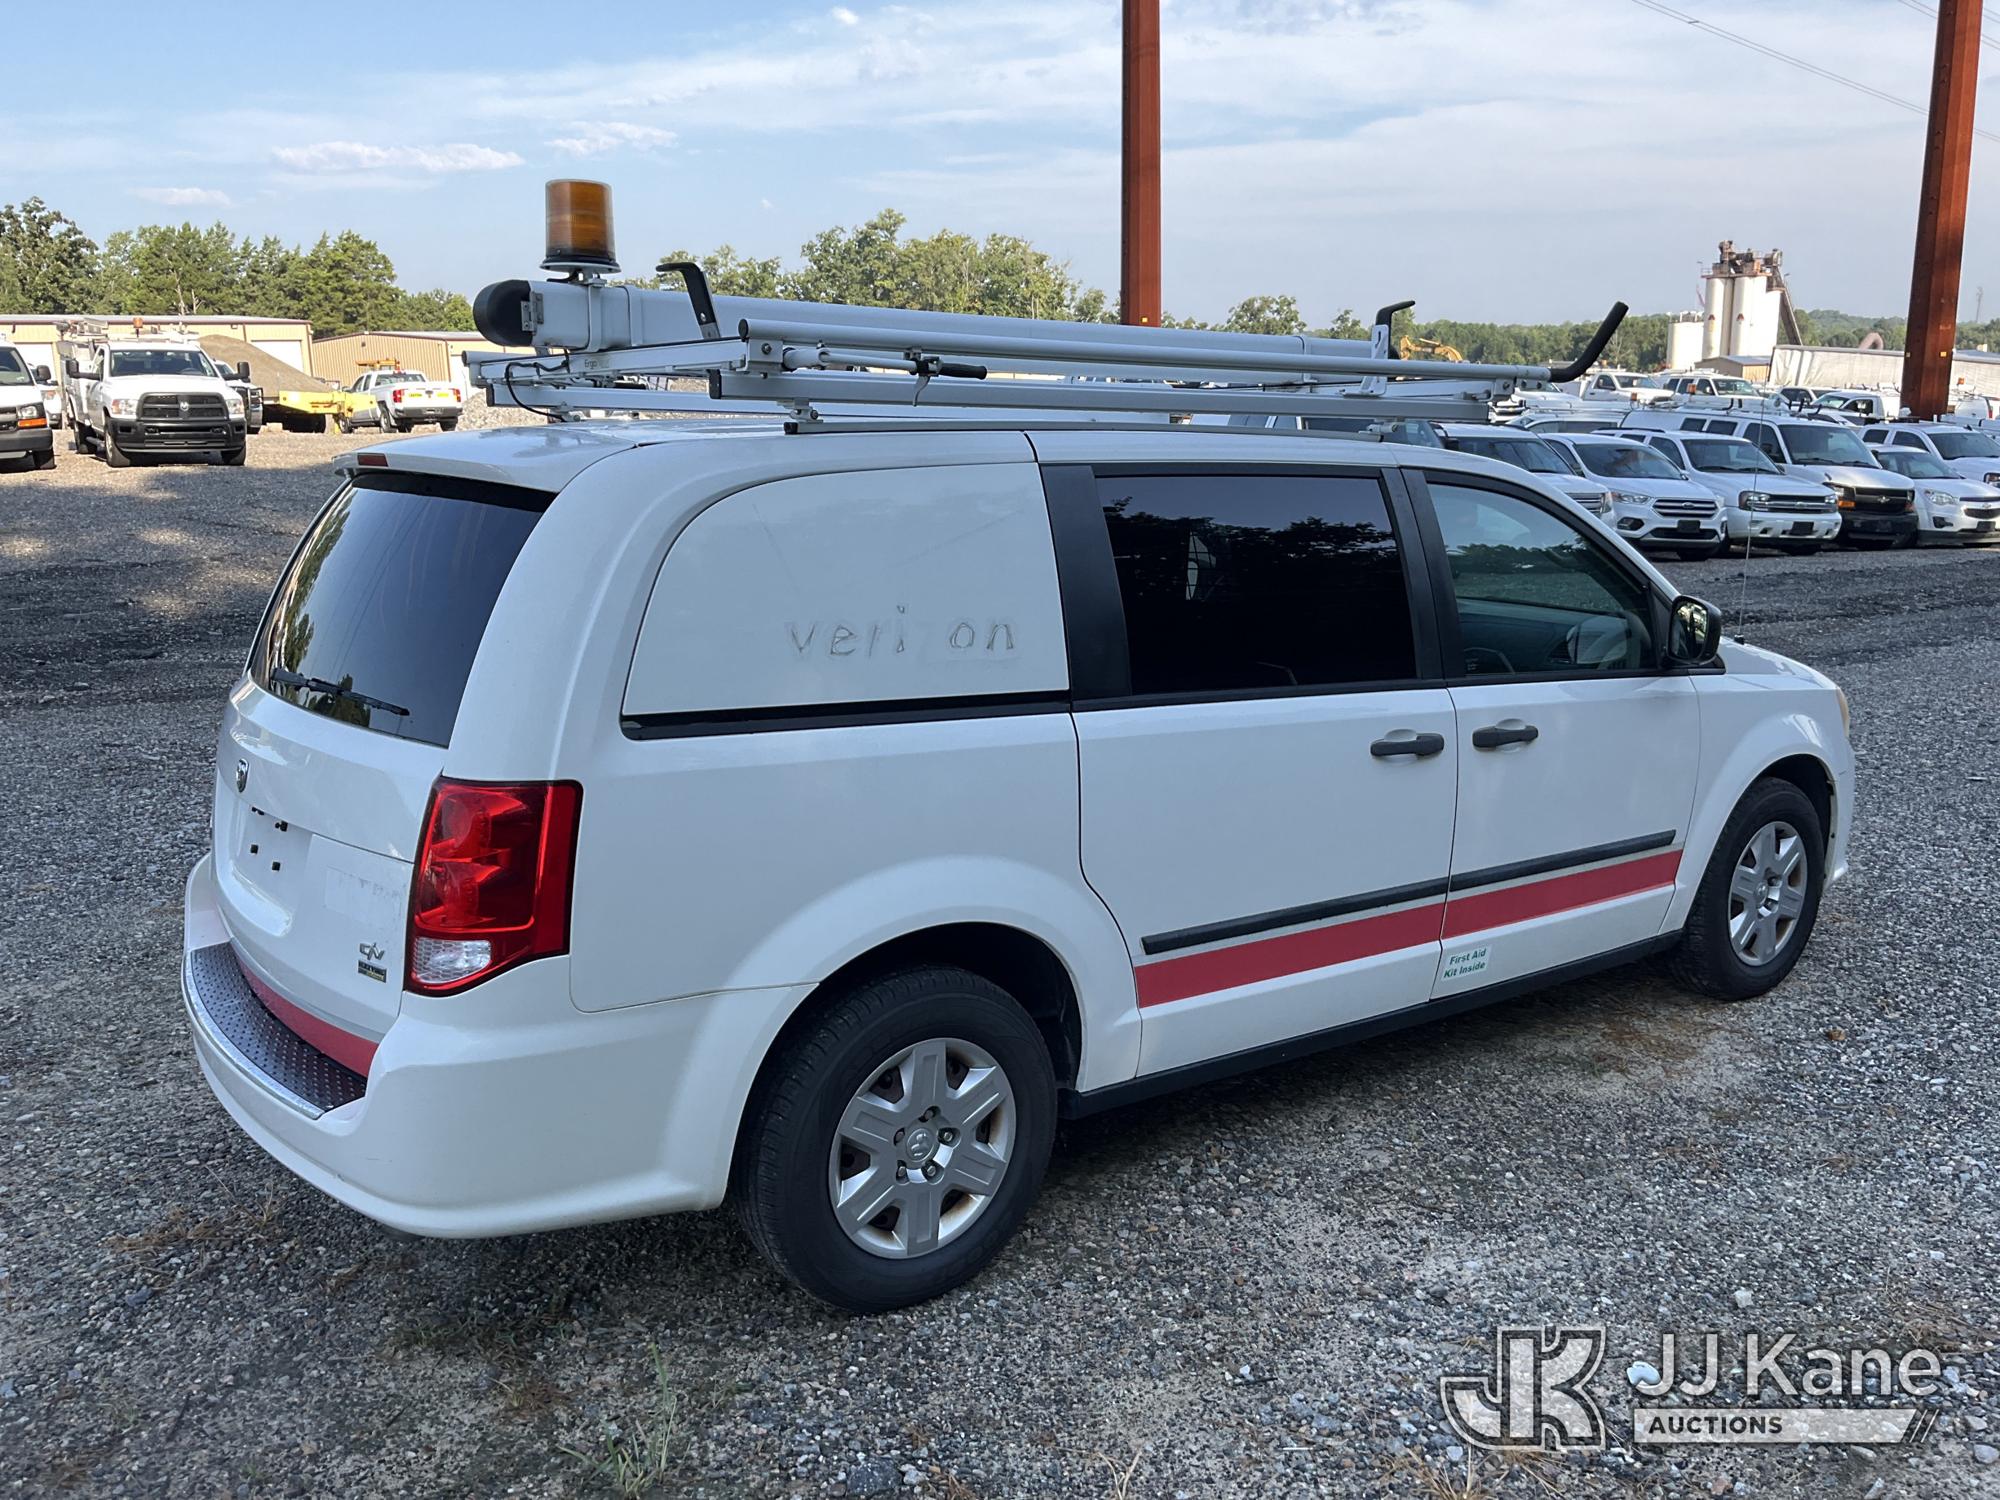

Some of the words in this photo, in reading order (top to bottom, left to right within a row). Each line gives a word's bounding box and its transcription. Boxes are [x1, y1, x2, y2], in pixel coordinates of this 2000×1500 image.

[788, 604, 1014, 658] verion
[1449, 953, 1470, 965] First
[1471, 948, 1487, 960] Aid
[1443, 968, 1458, 978] Kit
[1459, 962, 1485, 974] Inside
